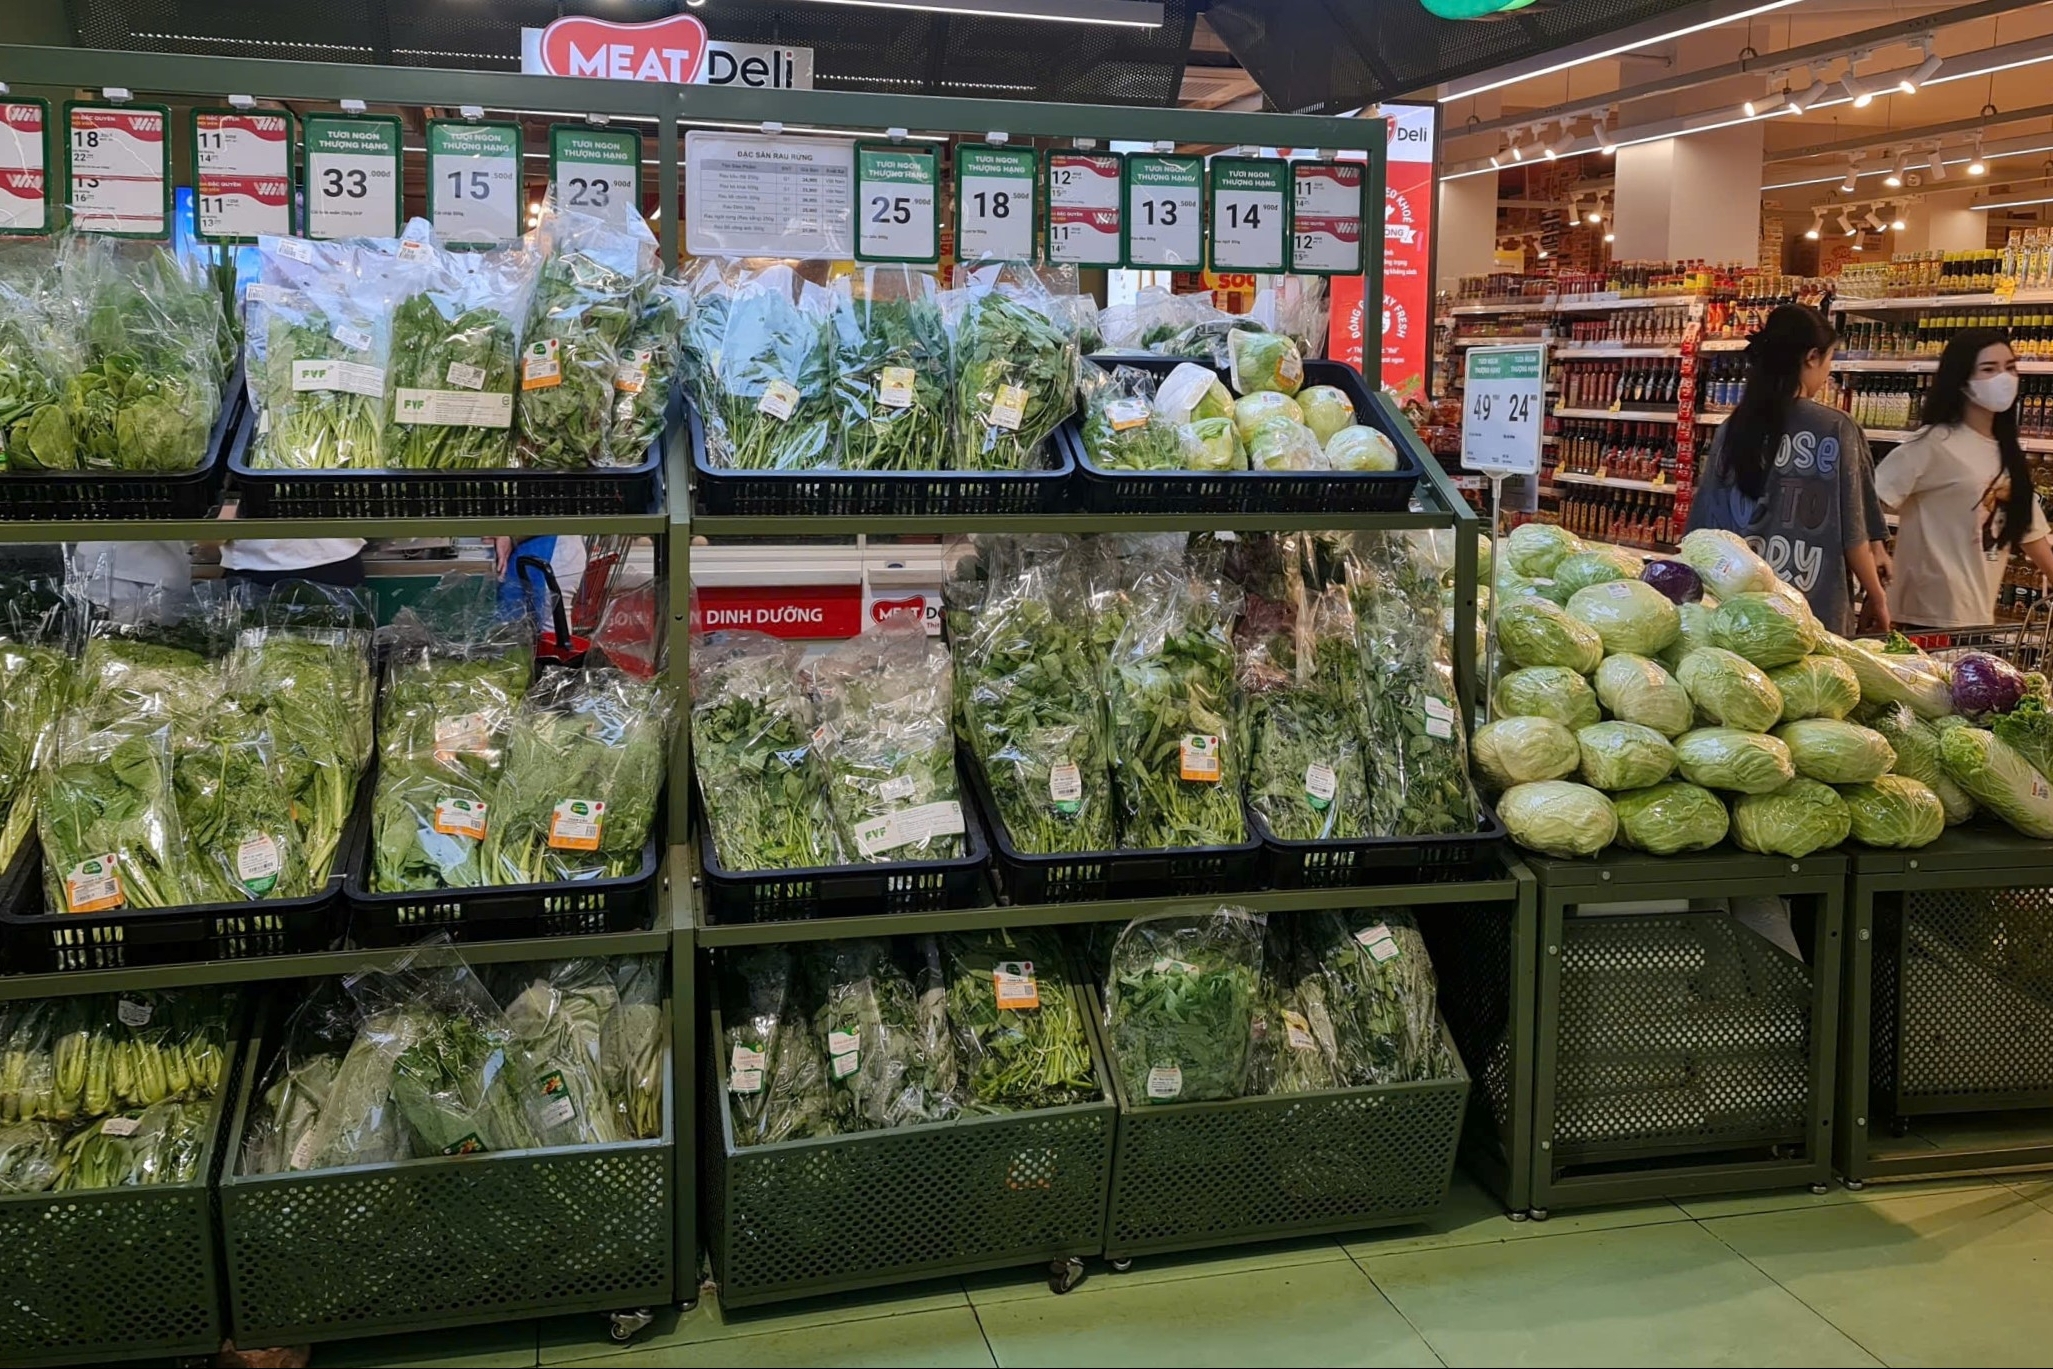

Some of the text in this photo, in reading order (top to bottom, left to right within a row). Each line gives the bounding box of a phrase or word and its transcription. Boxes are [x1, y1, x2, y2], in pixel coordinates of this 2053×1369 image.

[569, 41, 794, 89] MEAT Deli
[74, 131, 99, 148] 18
[199, 133, 221, 149] 11
[327, 129, 380, 141] TƯƠI NGON
[474, 134, 501, 142] NGON
[1397, 127, 1428, 143] Deli
[319, 139, 389, 151] THƯỢNG HẠNG
[442, 141, 510, 153] THƯỢNG HẠNG
[572, 139, 620, 150] TƯƠI NGON
[199, 154, 211, 162] 14
[564, 148, 629, 161] THƯỢNG HẠNG
[773, 152, 790, 161] RAU
[974, 154, 1019, 165] TƯƠI NGON
[896, 161, 921, 171] NGON
[967, 163, 1026, 175] THƯỢNG HẠNG
[1144, 165, 1163, 173] TƯƠI
[1052, 170, 1071, 185] 12
[1137, 172, 1194, 184] THƯỢNG HẠNG
[1228, 170, 1270, 179] TƯƠI NGON
[322, 168, 367, 199] 33
[447, 170, 490, 200] 15
[1221, 178, 1277, 189] THƯỢNG HẠNG
[1296, 181, 1311, 195] 11
[75, 194, 87, 202] 16
[568, 177, 610, 207] 23
[201, 197, 224, 213] 11
[871, 196, 911, 224] 25
[973, 191, 1010, 219] 18
[1142, 200, 1178, 226] 13
[1226, 203, 1261, 229] 14
[1051, 226, 1068, 240] 11
[1295, 235, 1313, 249] 12
[1393, 303, 1408, 339] FRESH
[1473, 393, 1491, 421] 49
[1508, 393, 1529, 423] 24
[706, 609, 751, 625] DINH
[756, 605, 824, 624] DƯỠNG
